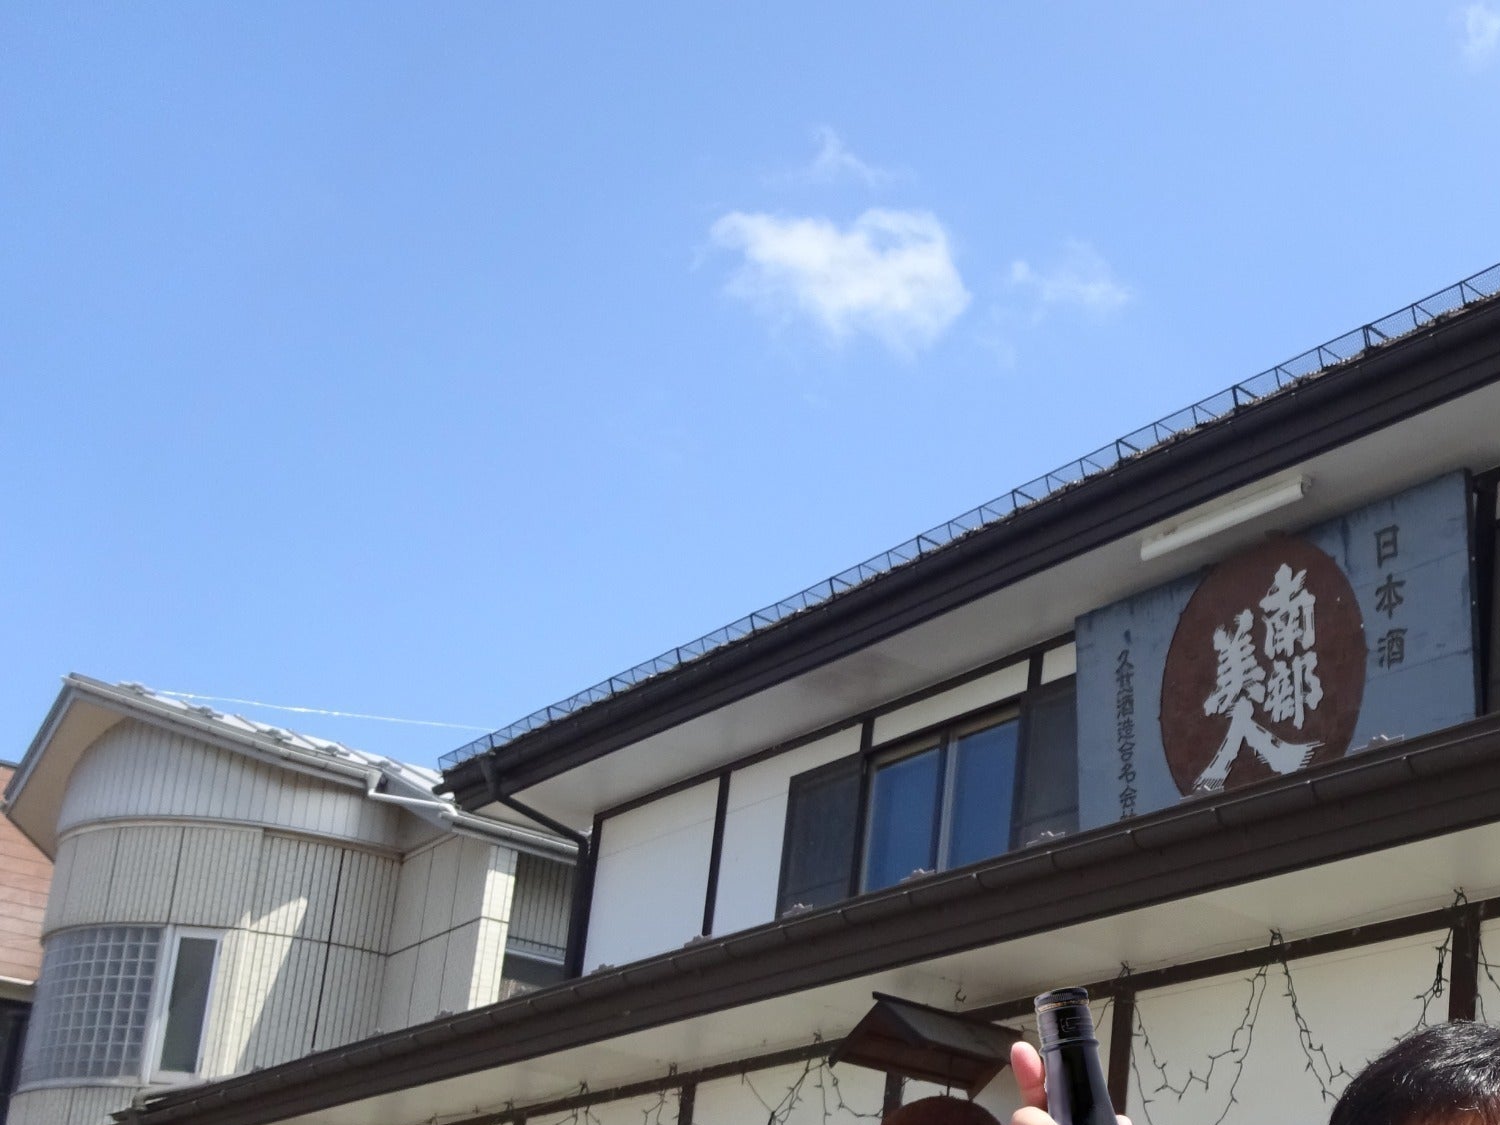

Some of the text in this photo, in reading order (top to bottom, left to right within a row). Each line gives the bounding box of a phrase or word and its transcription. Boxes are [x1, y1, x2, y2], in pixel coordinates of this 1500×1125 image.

[1259, 562, 1323, 730] 南部
[1374, 524, 1408, 671] 日本酒
[1193, 608, 1325, 790] 美人
